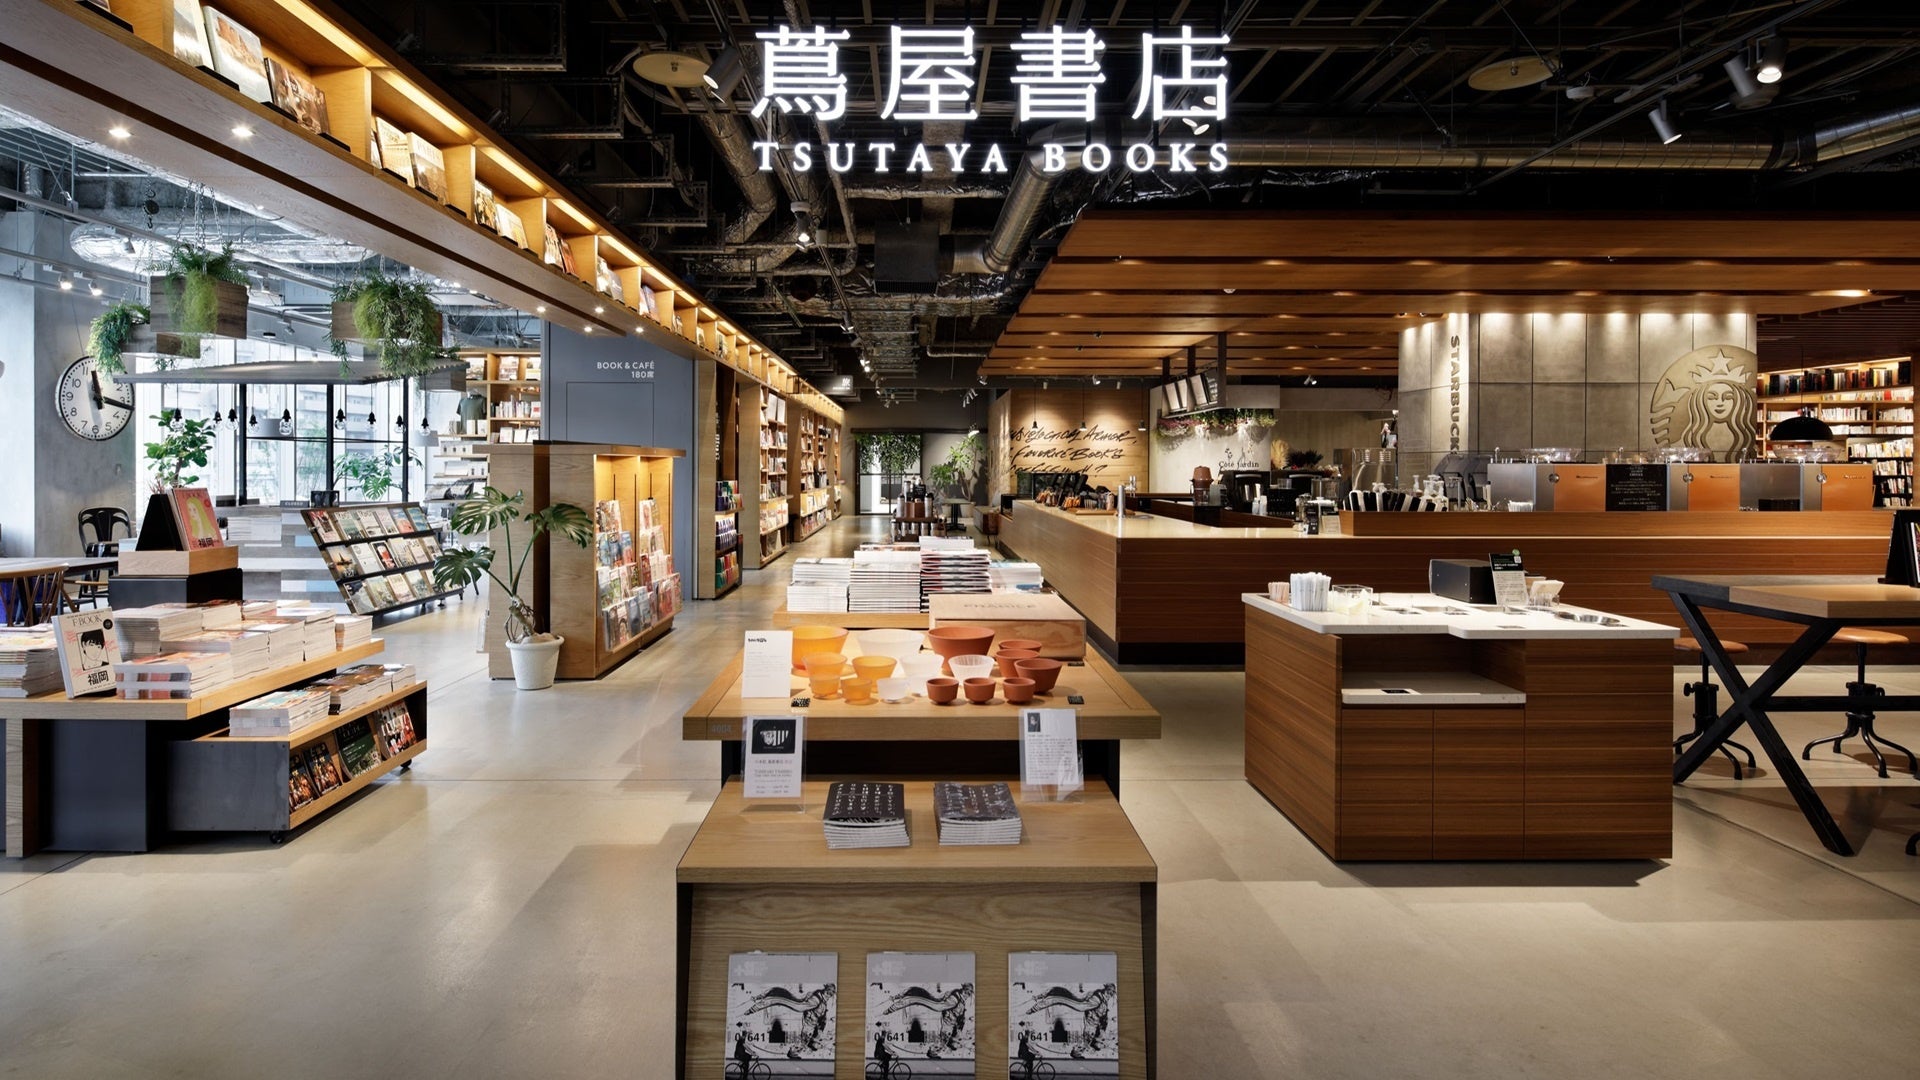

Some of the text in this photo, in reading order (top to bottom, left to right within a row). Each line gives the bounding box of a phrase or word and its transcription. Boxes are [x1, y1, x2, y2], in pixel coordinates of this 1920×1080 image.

[750, 25, 1231, 122] 蔦屋書店
[752, 142, 1229, 173] TSUTAYA BOOKS
[597, 360, 655, 370] BOOK & CAFÉ
[72, 378, 82, 388] 10
[66, 391, 74, 401] 9
[1450, 335, 1460, 455] STARBUCK
[70, 407, 77, 417] 8
[113, 410, 120, 420] 4
[81, 420, 88, 430] 7
[92, 424, 100, 434] 6
[105, 422, 112, 432] 5
[88, 670, 109, 686] 福岡
